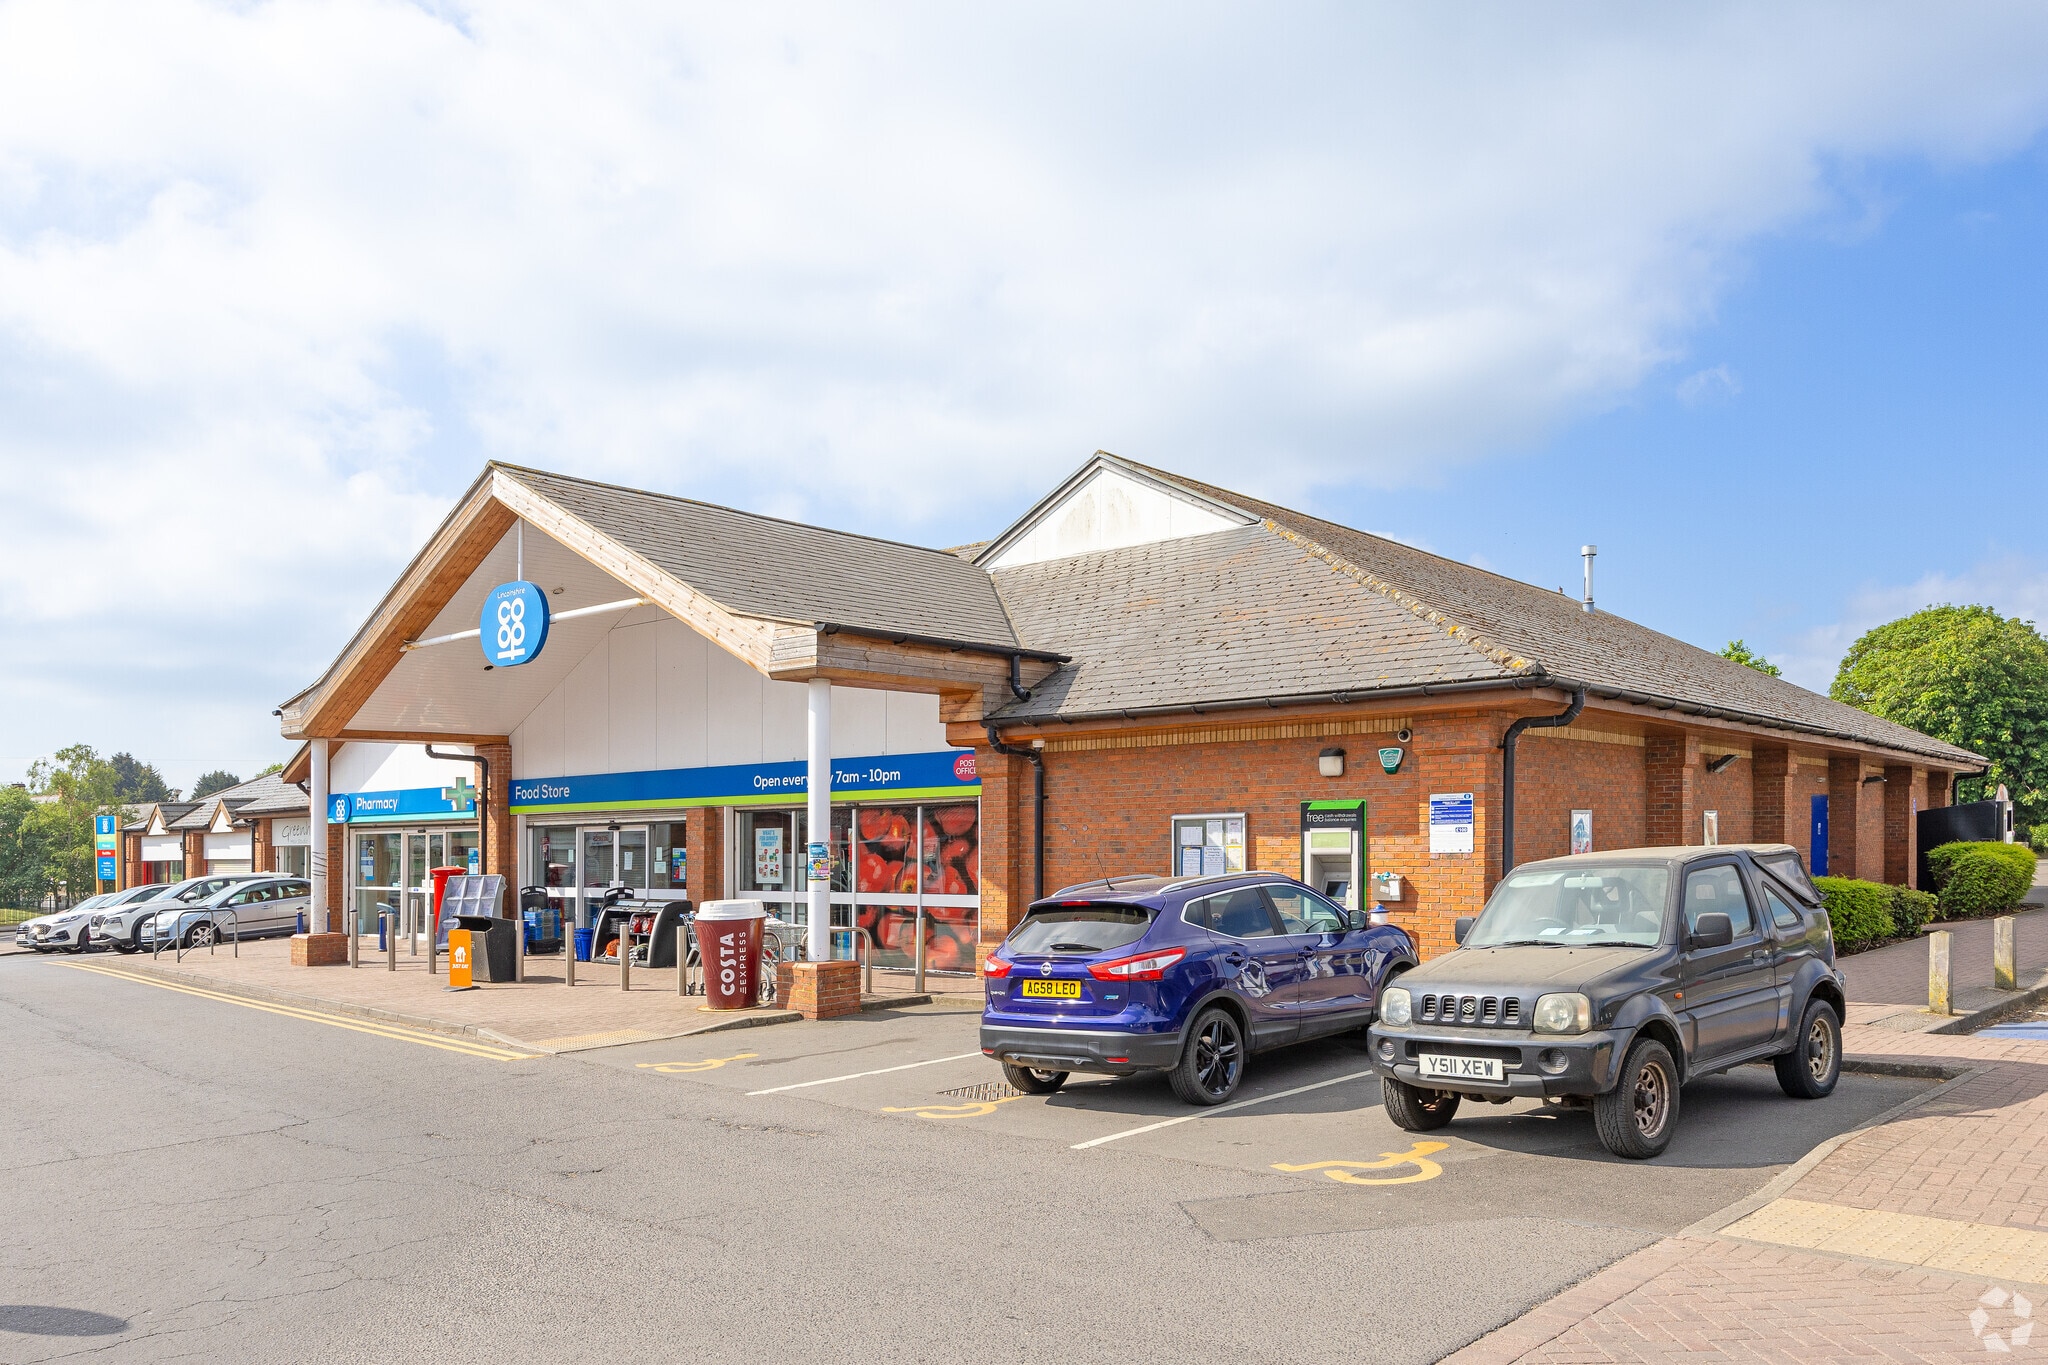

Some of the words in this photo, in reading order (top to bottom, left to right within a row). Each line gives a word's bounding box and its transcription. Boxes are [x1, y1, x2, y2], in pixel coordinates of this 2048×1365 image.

[497, 587, 526, 599] Lincolnshire
[959, 759, 976, 767] POST
[753, 774, 781, 790] Open
[835, 770, 860, 784] 7am
[869, 767, 901, 785] 10pm
[515, 784, 540, 800] Food
[541, 783, 570, 799] Store
[356, 797, 398, 812] Pharmacy
[1306, 811, 1325, 823] free
[720, 932, 737, 996] COSTA
[738, 931, 747, 985] EXPRESS
[1027, 982, 1053, 994] AG58
[1055, 982, 1076, 995] LEO
[1428, 1057, 1457, 1074] Y511
[1461, 1059, 1494, 1076] XEW
